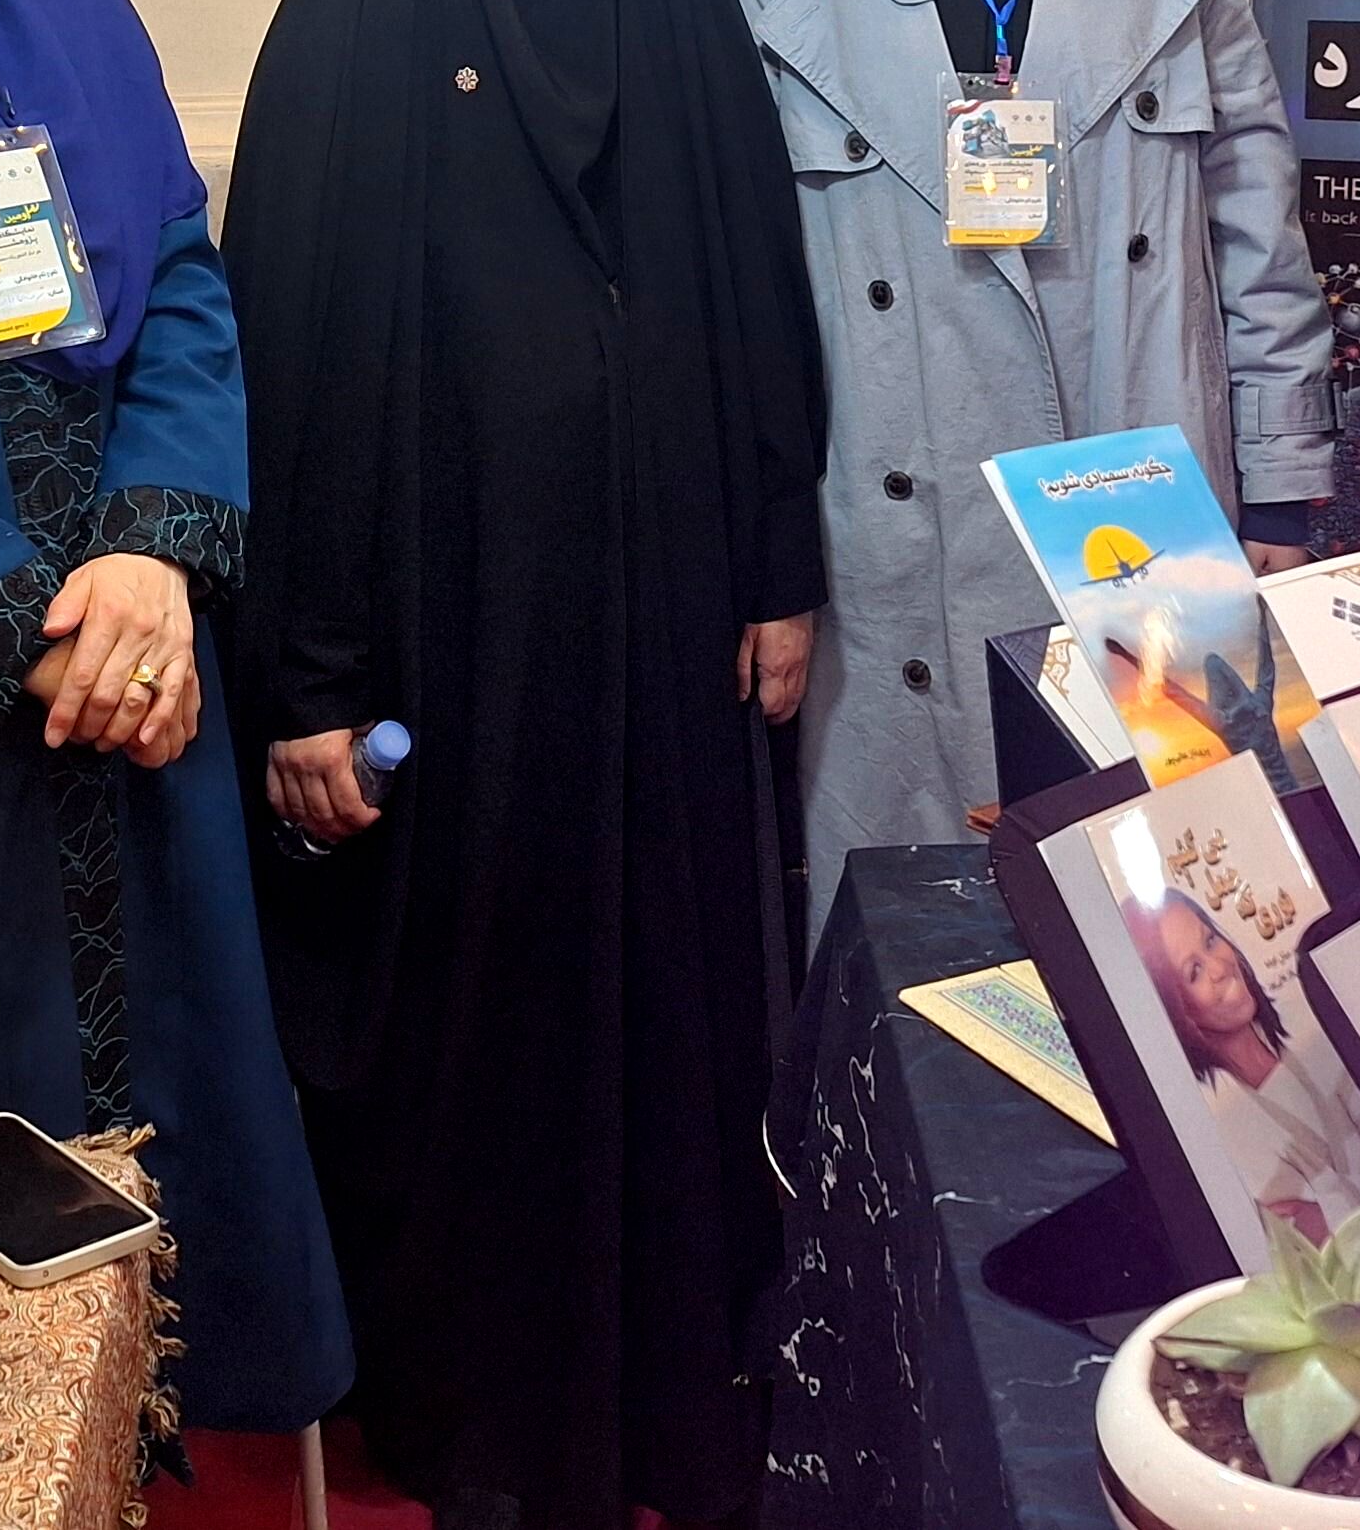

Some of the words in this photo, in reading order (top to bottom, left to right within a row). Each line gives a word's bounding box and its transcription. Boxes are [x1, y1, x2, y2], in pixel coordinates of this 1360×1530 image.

[1322, 210, 1358, 225] back
[1082, 470, 1129, 490] سمپادی
[1132, 459, 1172, 481] چگونه
